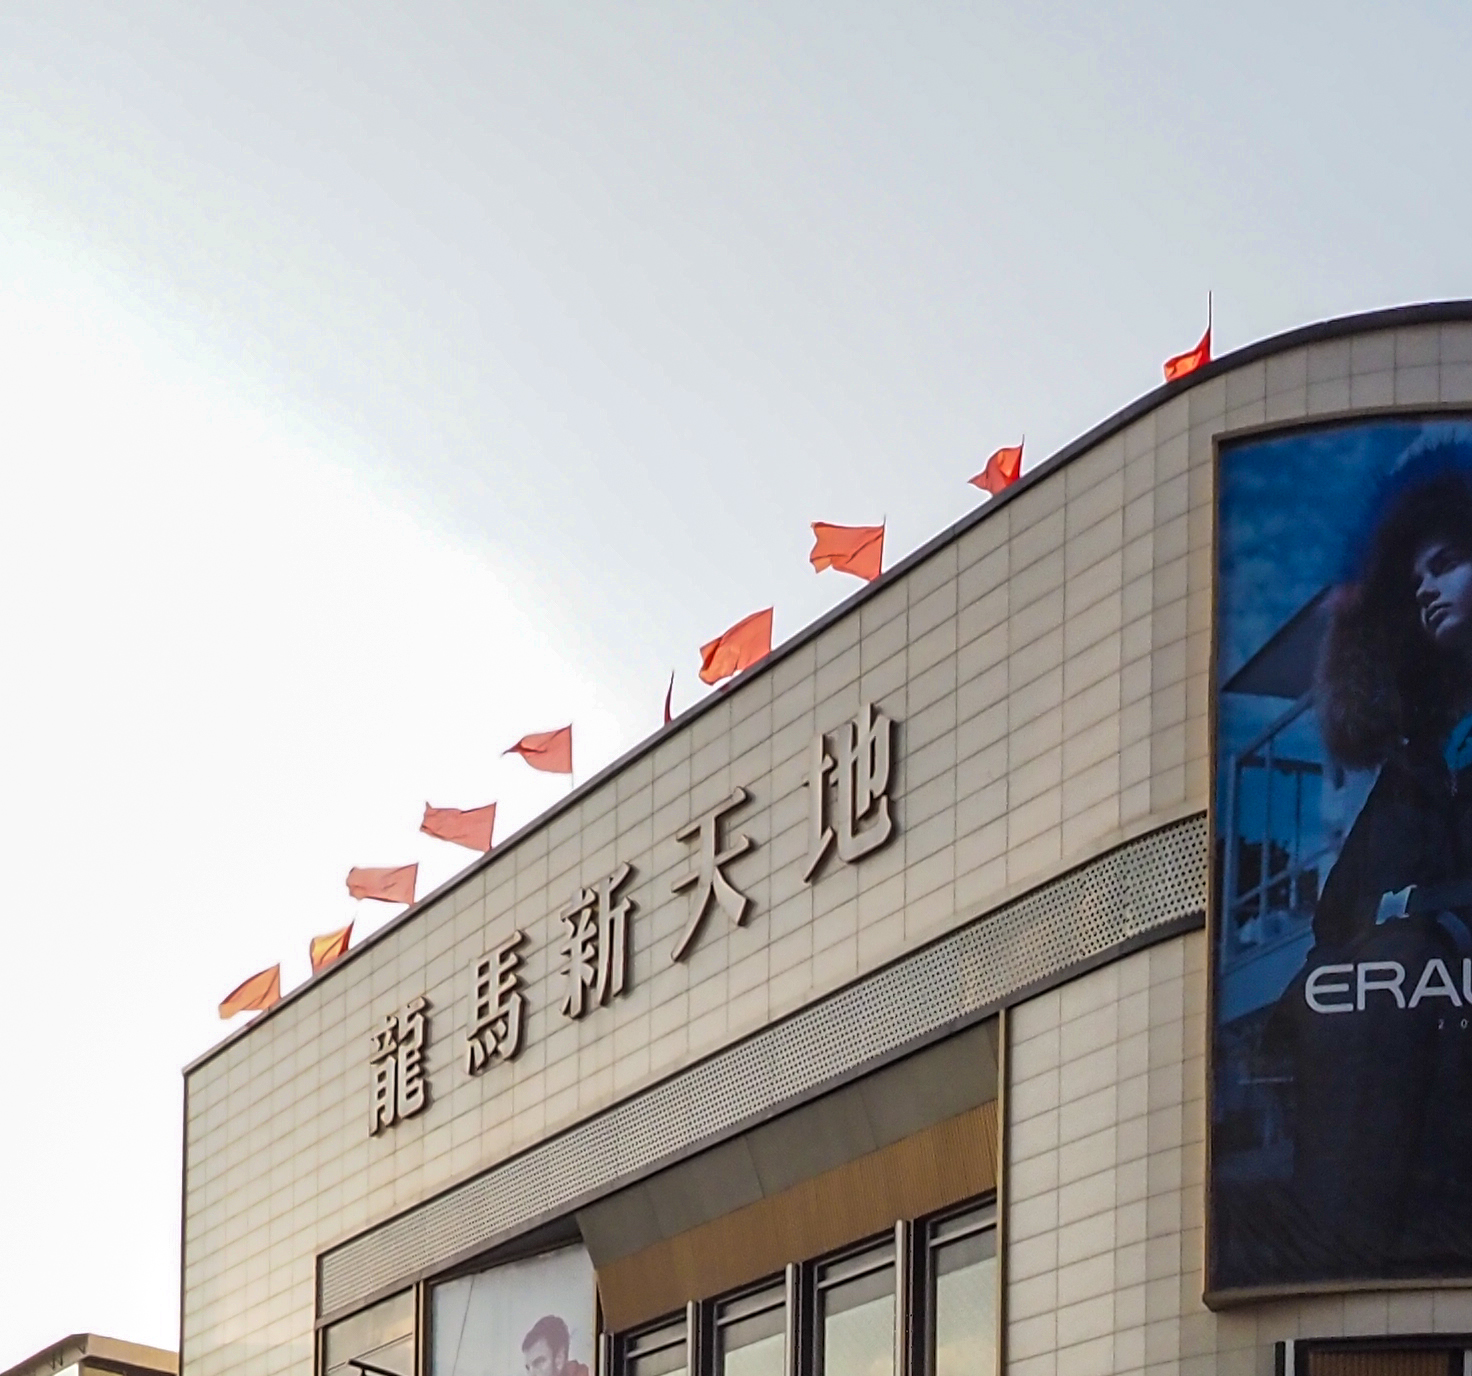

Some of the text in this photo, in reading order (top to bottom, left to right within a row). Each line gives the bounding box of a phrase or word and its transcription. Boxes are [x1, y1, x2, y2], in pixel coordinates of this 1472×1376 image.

[368, 702, 896, 1136] 龍馬新天地
